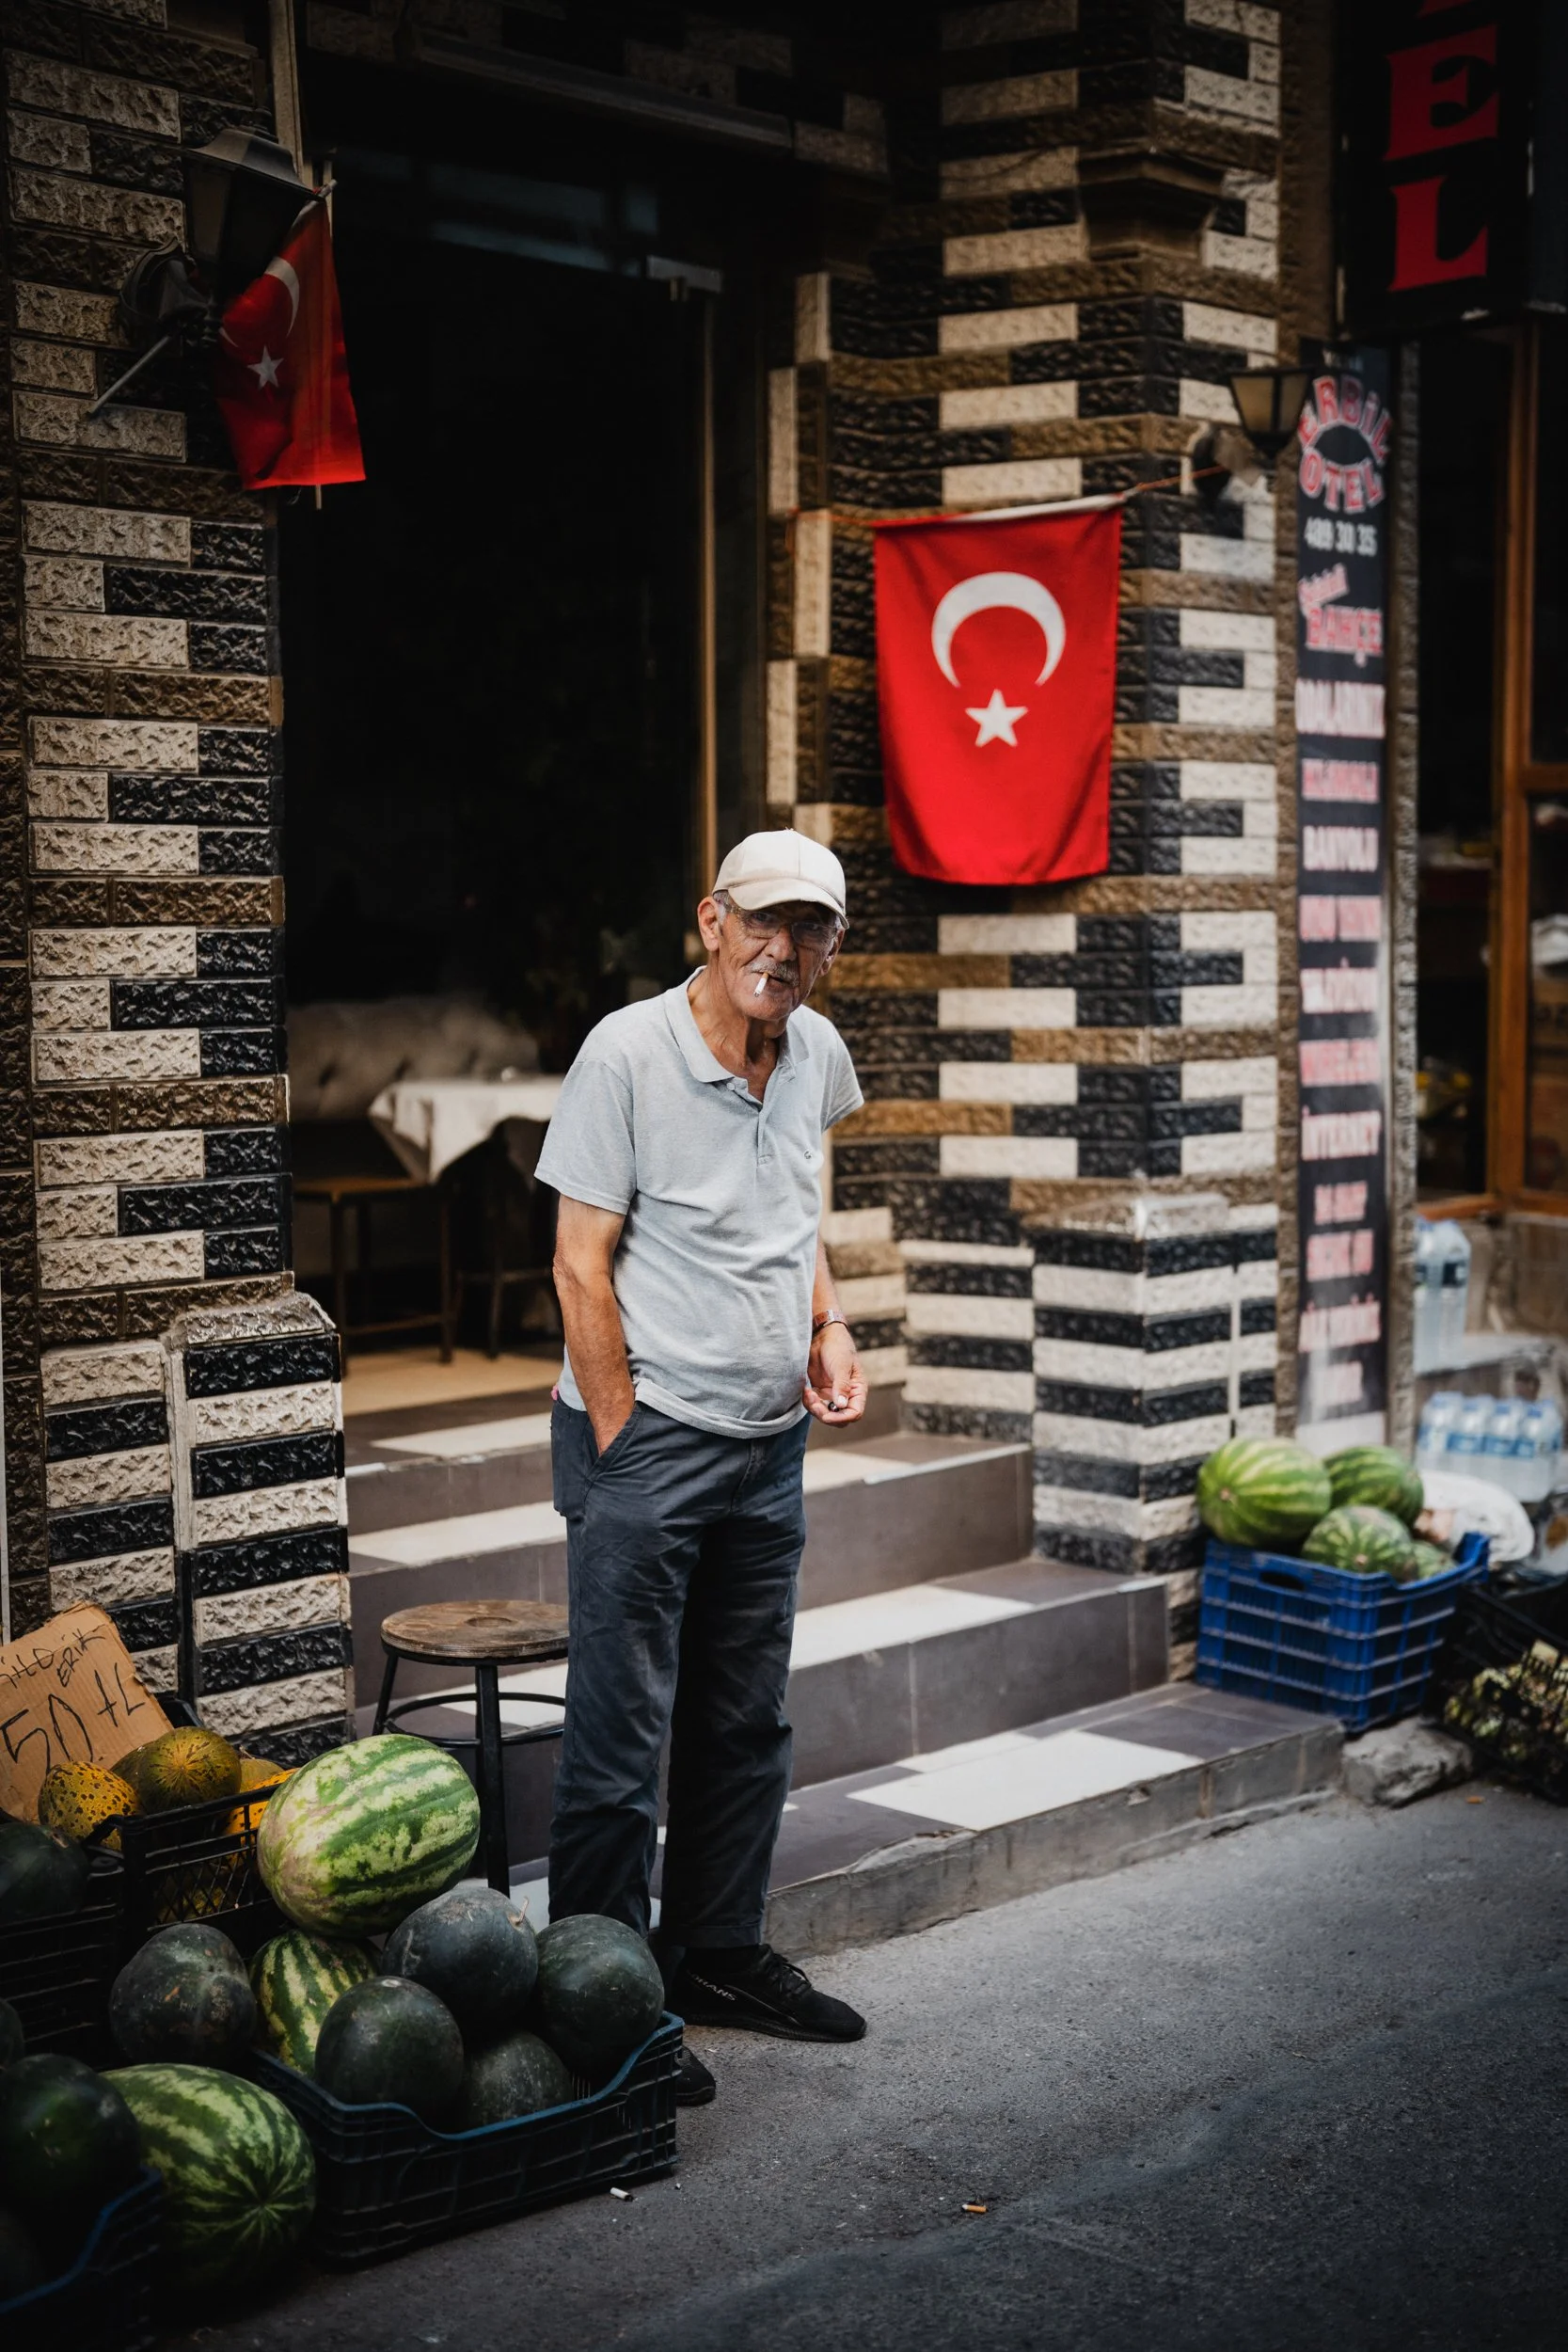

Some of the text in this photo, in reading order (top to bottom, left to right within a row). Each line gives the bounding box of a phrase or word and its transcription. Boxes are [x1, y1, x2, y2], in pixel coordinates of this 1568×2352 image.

[1383, 0, 1499, 292] EL
[1299, 447, 1385, 513] OTEL
[0, 1693, 93, 1777] 50
